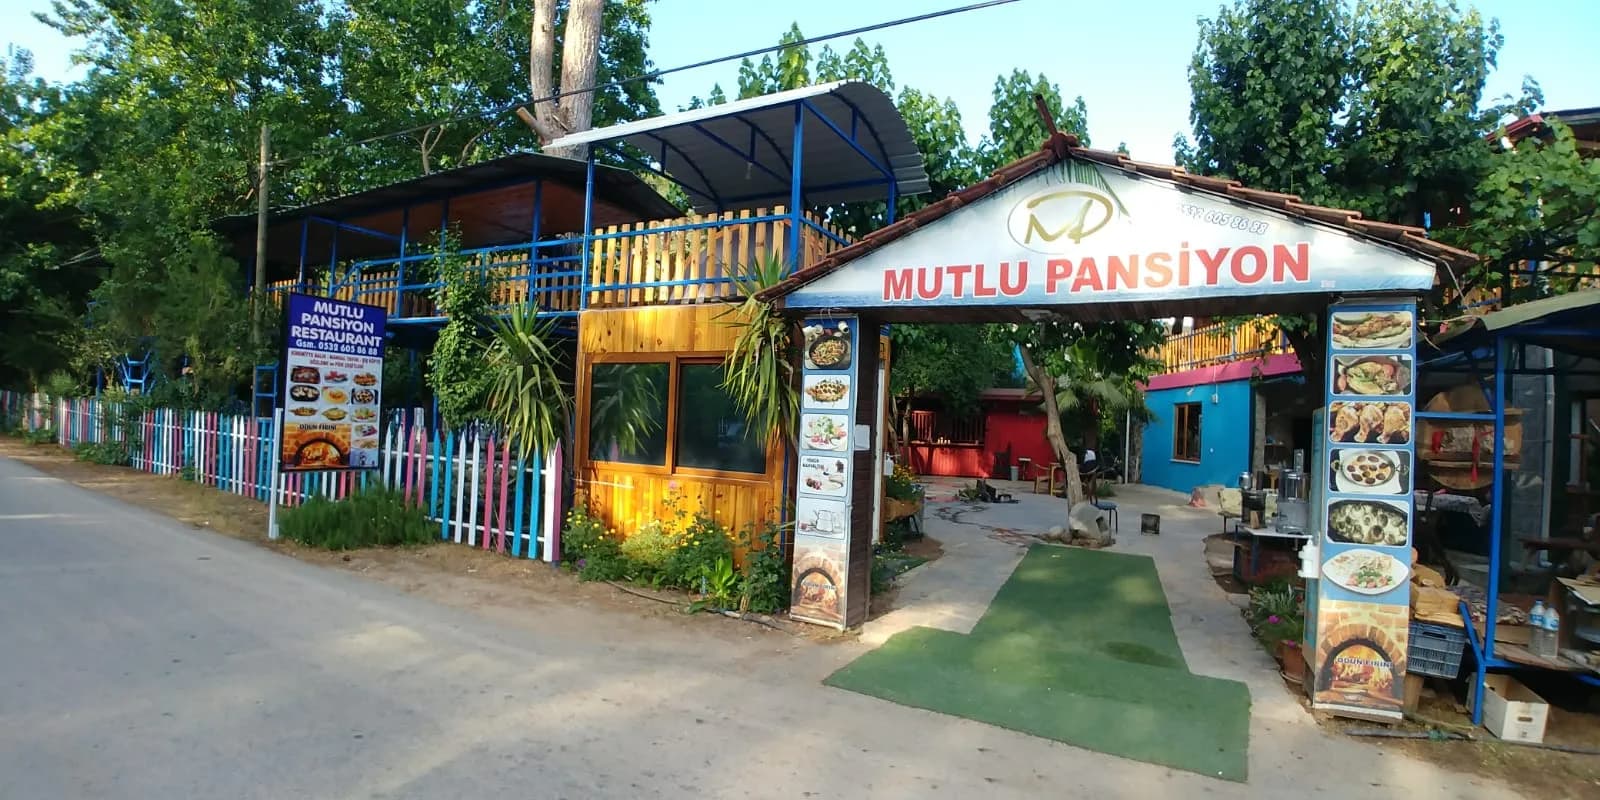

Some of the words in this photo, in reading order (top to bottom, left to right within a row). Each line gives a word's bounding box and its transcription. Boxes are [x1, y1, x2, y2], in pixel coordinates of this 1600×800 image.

[1205, 209, 1230, 225] 605
[1230, 215, 1249, 231] 86
[1249, 220, 1269, 235] 88
[883, 260, 1029, 301] MUTLU
[1046, 241, 1309, 294] PANSİYON
[314, 301, 364, 319] MUTLU
[301, 312, 374, 334] PANSİYON
[291, 325, 382, 347] RESTAURANT
[295, 339, 317, 349] Gsm.
[318, 341, 339, 352] 0532
[340, 343, 356, 353] 605
[357, 346, 367, 355] 86
[368, 348, 378, 356] 88
[1337, 657, 1363, 665] ODUN
